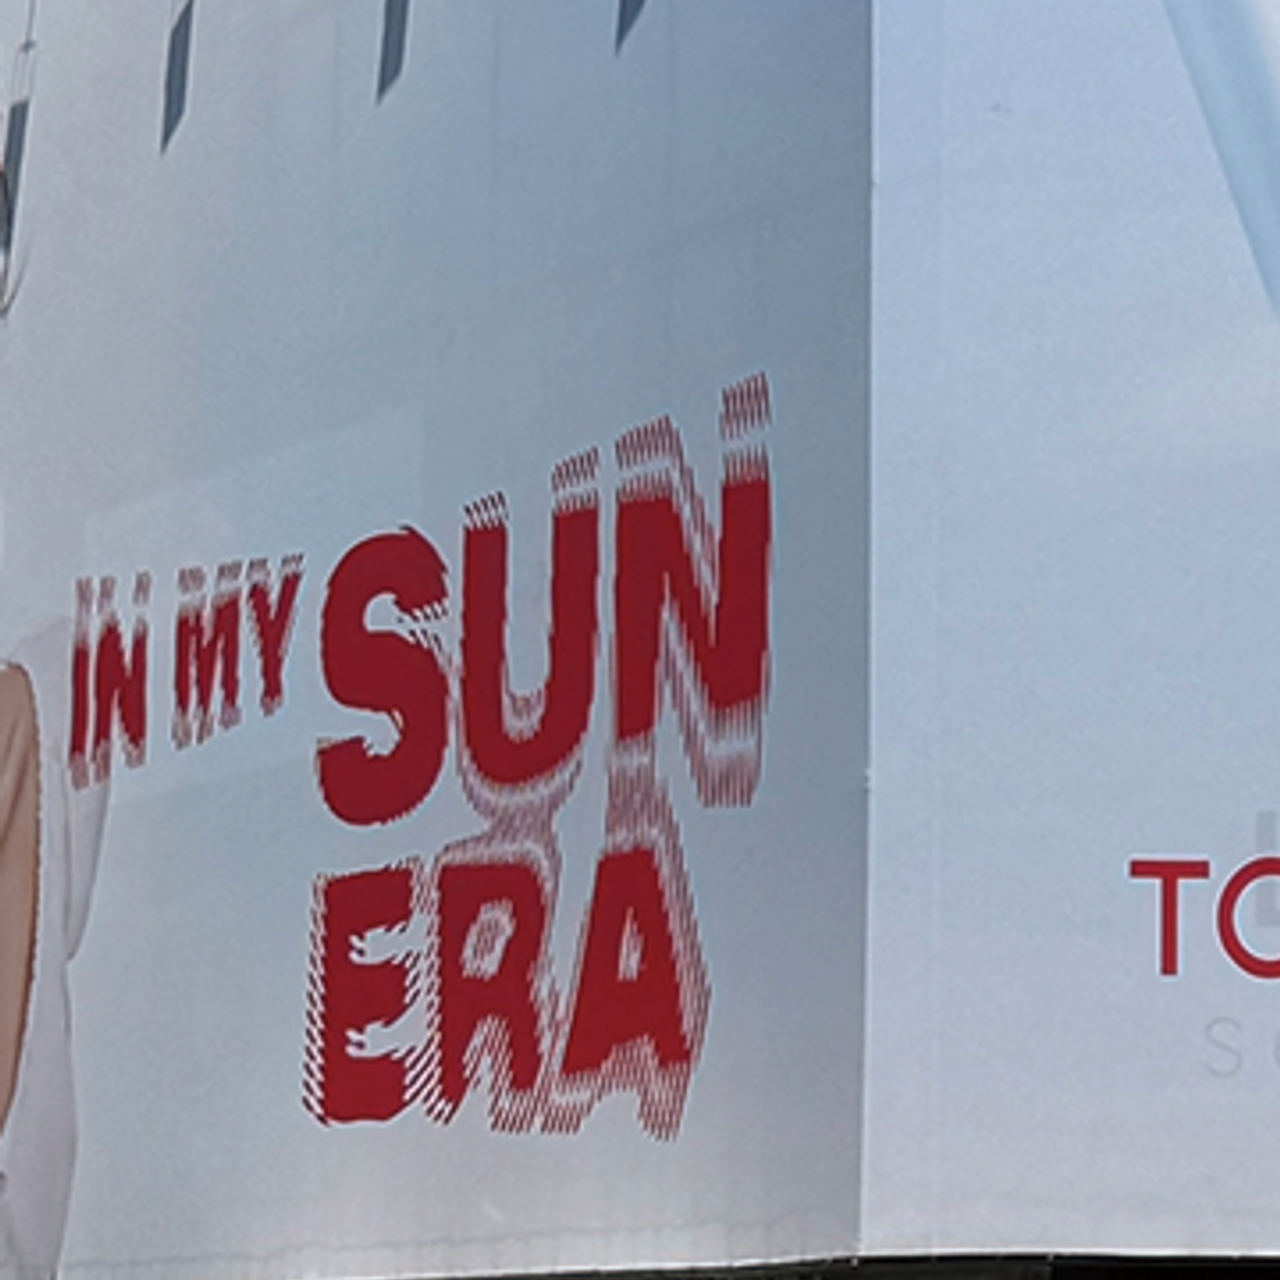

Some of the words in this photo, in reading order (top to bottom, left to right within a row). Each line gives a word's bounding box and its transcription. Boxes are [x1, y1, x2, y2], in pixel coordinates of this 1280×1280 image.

[68, 576, 151, 791] IN
[171, 553, 304, 751] MY
[314, 372, 771, 826] SUN
[303, 835, 711, 1141] ERA
